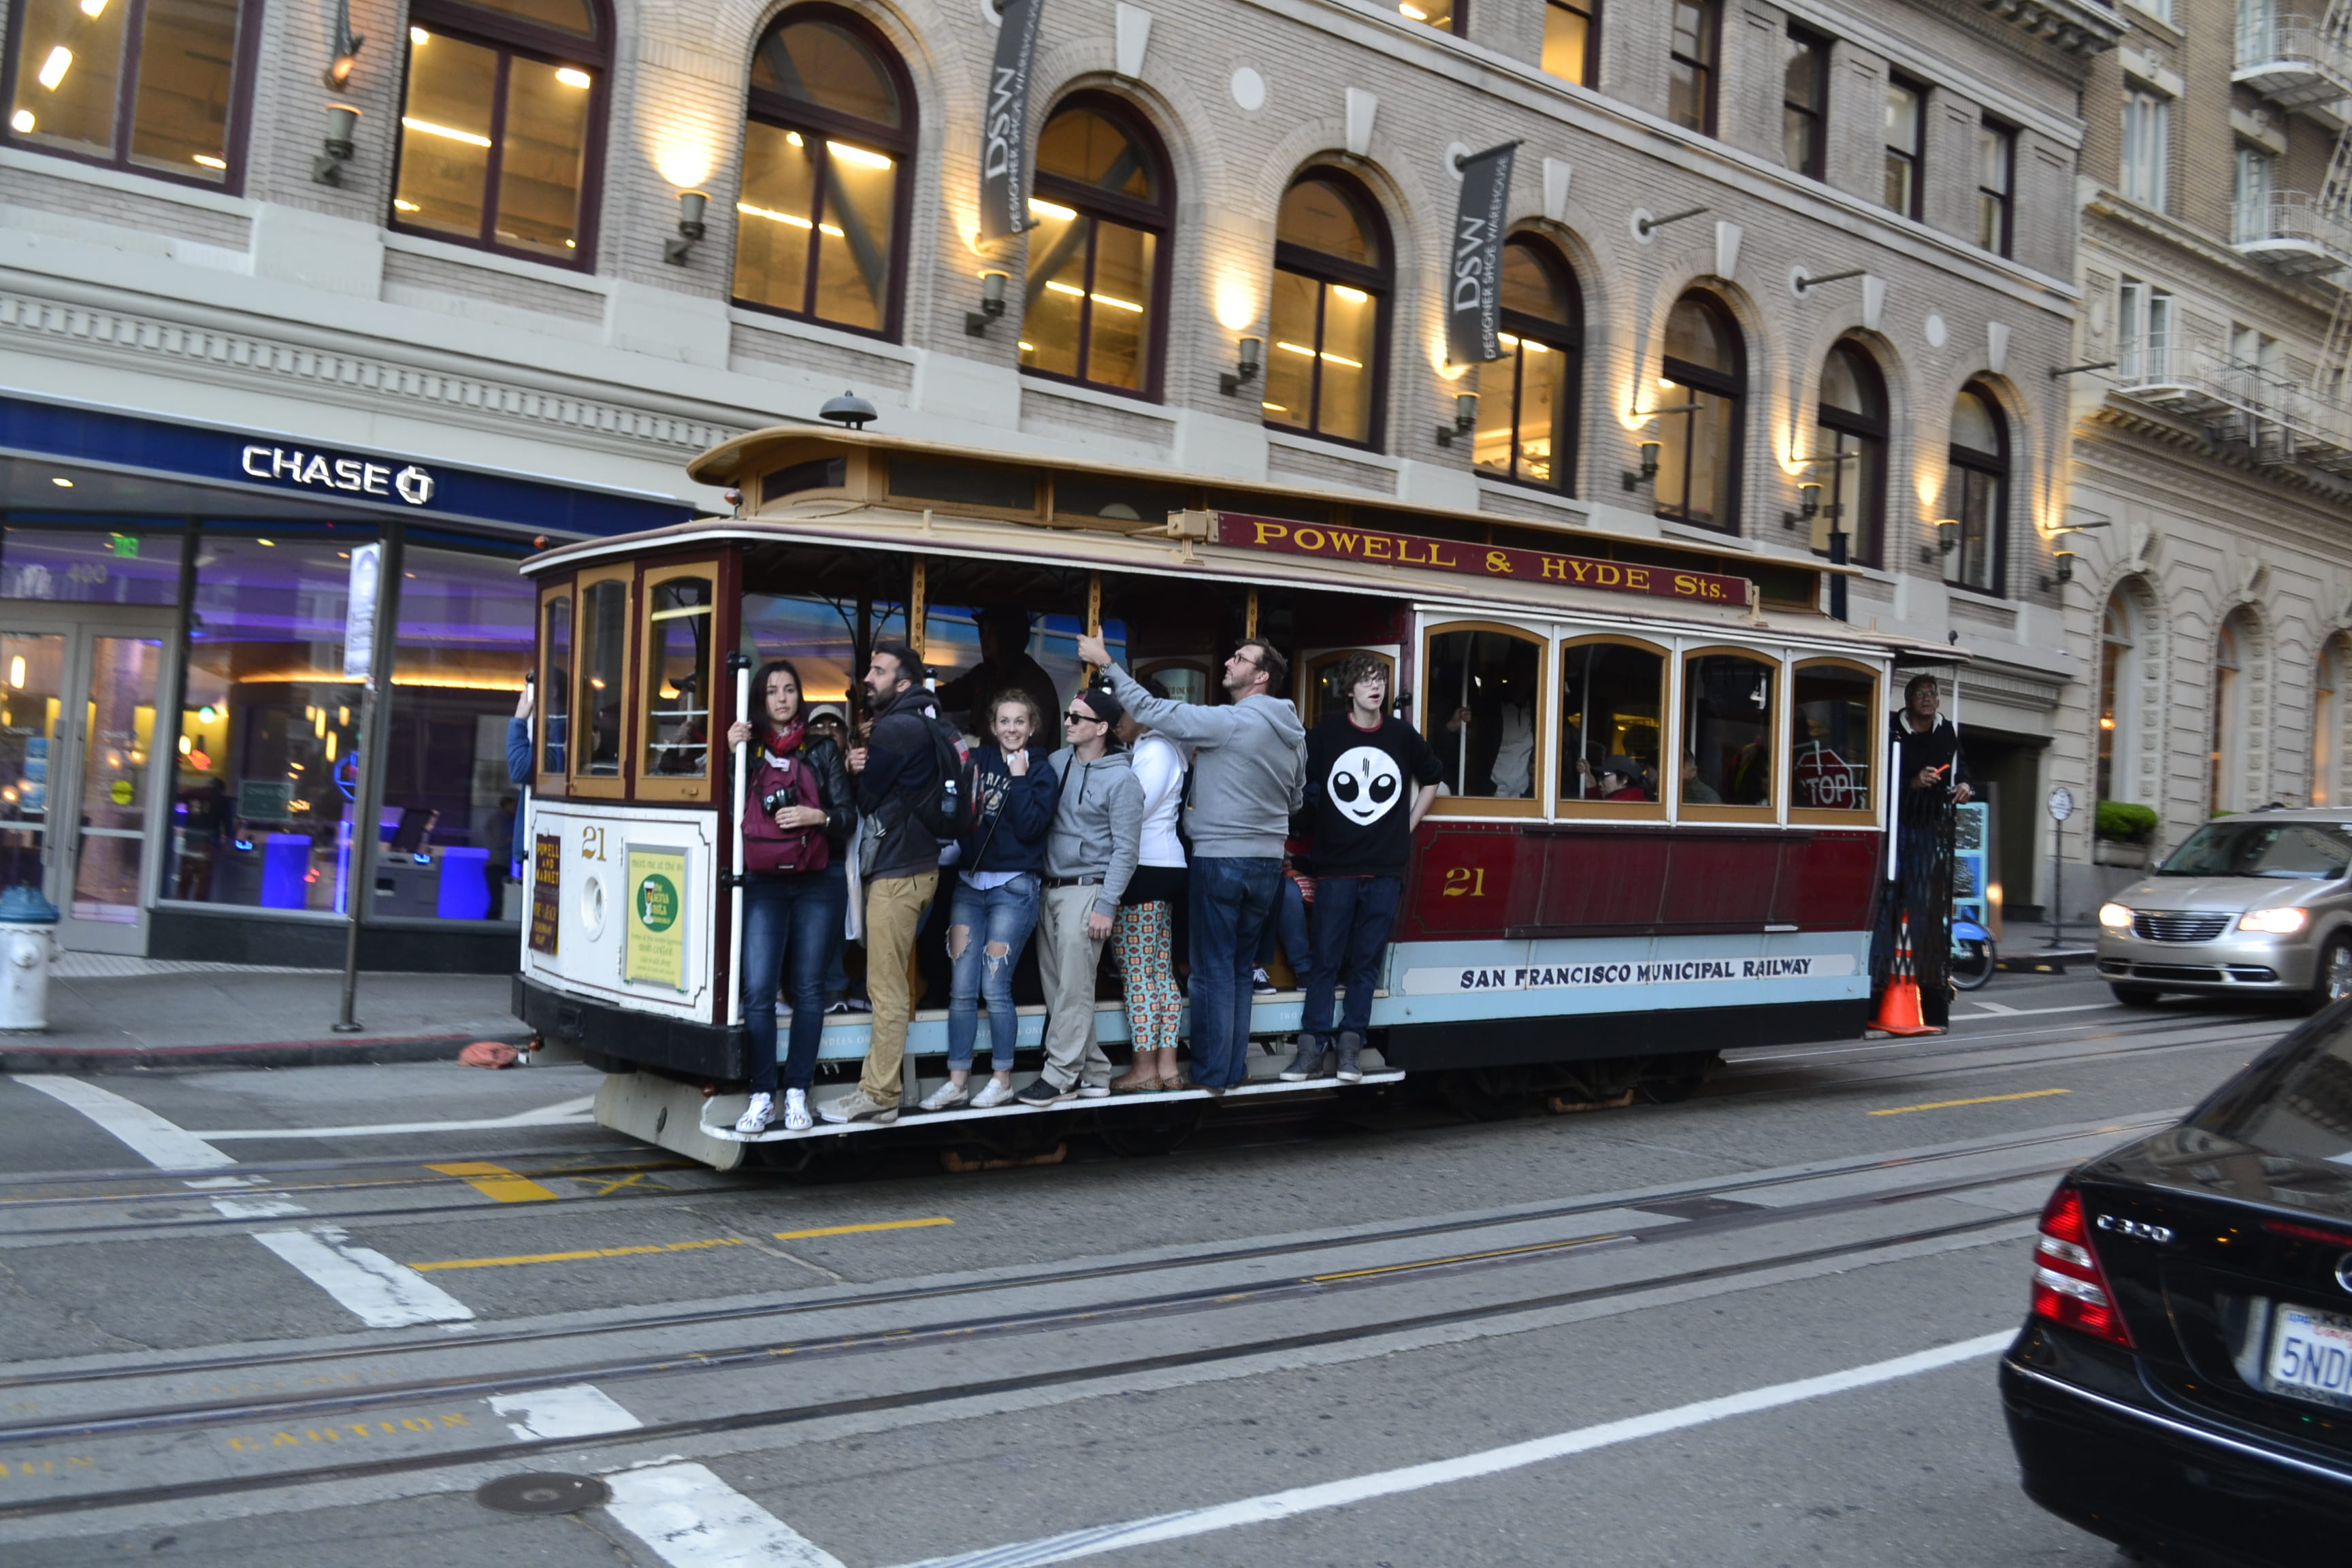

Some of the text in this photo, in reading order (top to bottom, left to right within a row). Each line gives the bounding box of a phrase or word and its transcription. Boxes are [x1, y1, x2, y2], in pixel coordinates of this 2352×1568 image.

[985, 66, 1015, 182] DSW
[1454, 216, 1486, 314] DSW
[1481, 154, 1509, 359] DESIGNER SHOE WAREHOUSE
[242, 444, 391, 495] CHASE
[1254, 522, 1728, 598] POWELL & HYDE Sts.
[1800, 774, 1849, 806] TOP
[582, 826, 607, 862] 21
[1443, 868, 1486, 896] 21
[1460, 958, 1812, 989] SAN FRANCISCO MUNICIPAL RAILWAY
[227, 1413, 468, 1451] CAUTION
